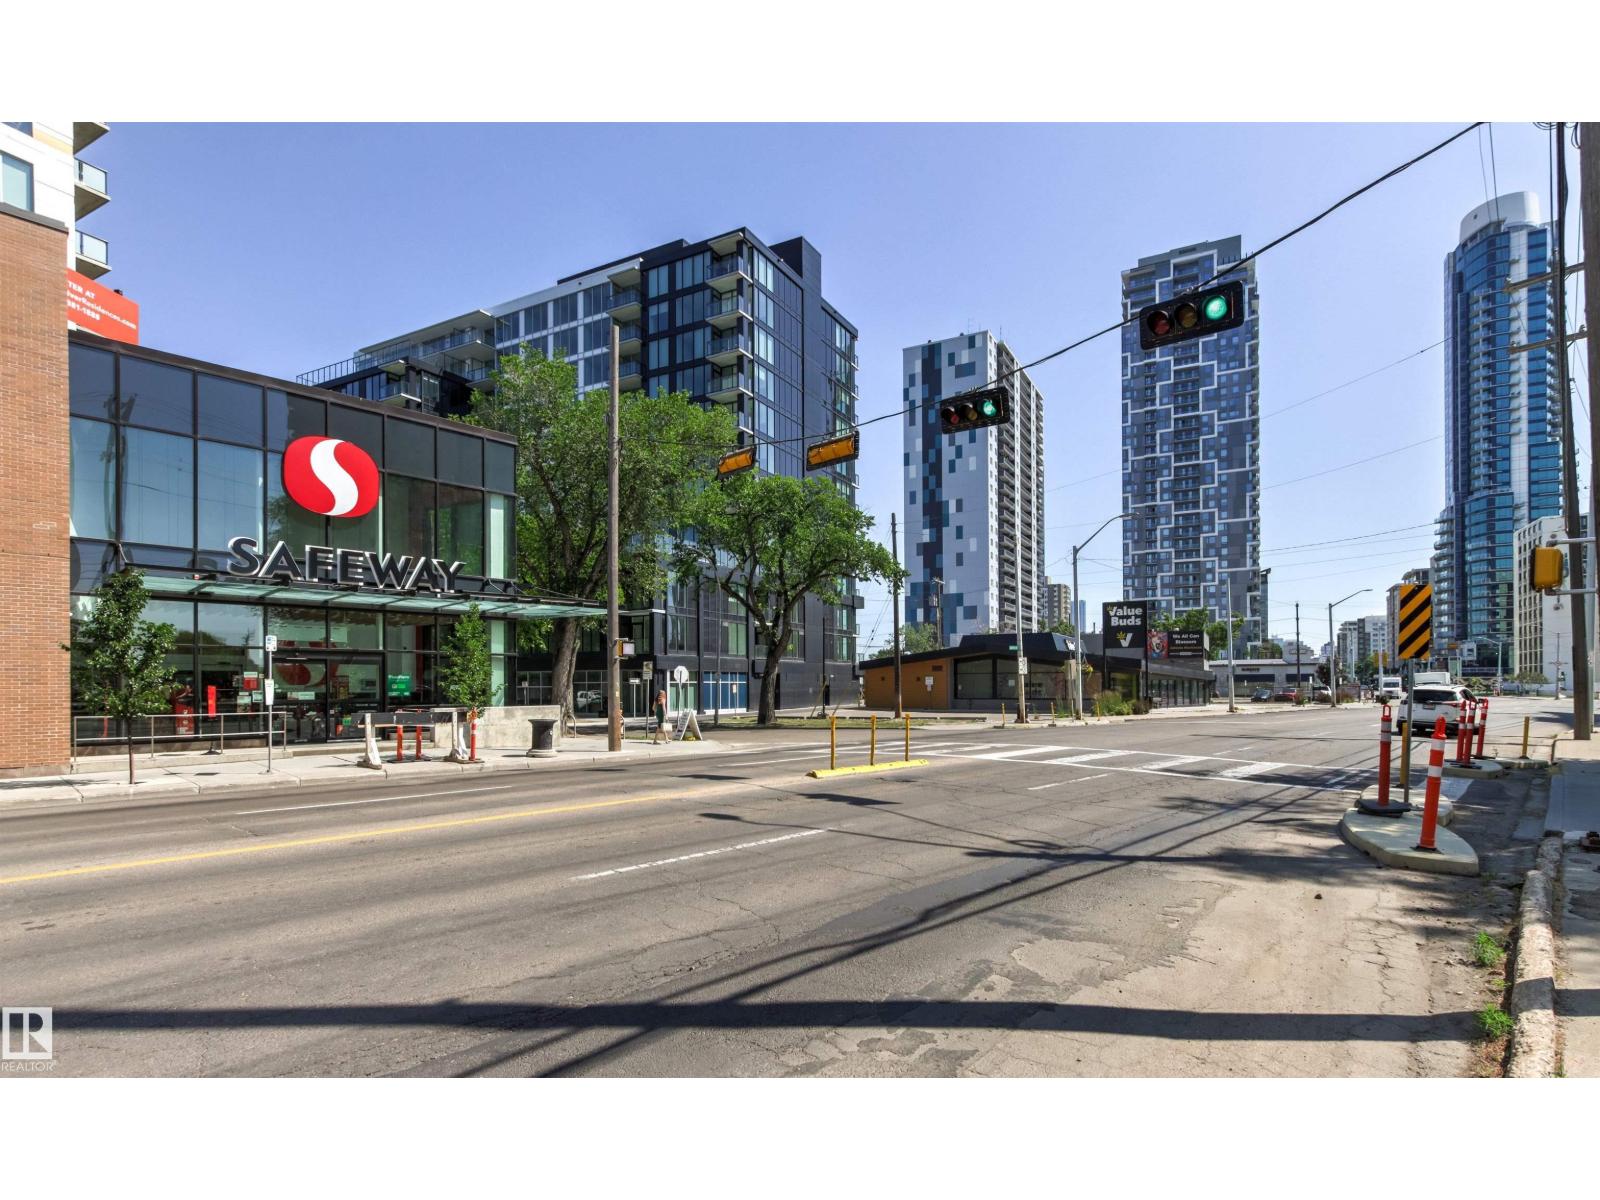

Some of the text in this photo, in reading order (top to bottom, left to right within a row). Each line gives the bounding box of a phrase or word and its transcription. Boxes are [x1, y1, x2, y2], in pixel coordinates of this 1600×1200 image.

[227, 536, 467, 594] SAFEWAY
[1108, 605, 1143, 616] Value
[1111, 616, 1142, 626] Buds
